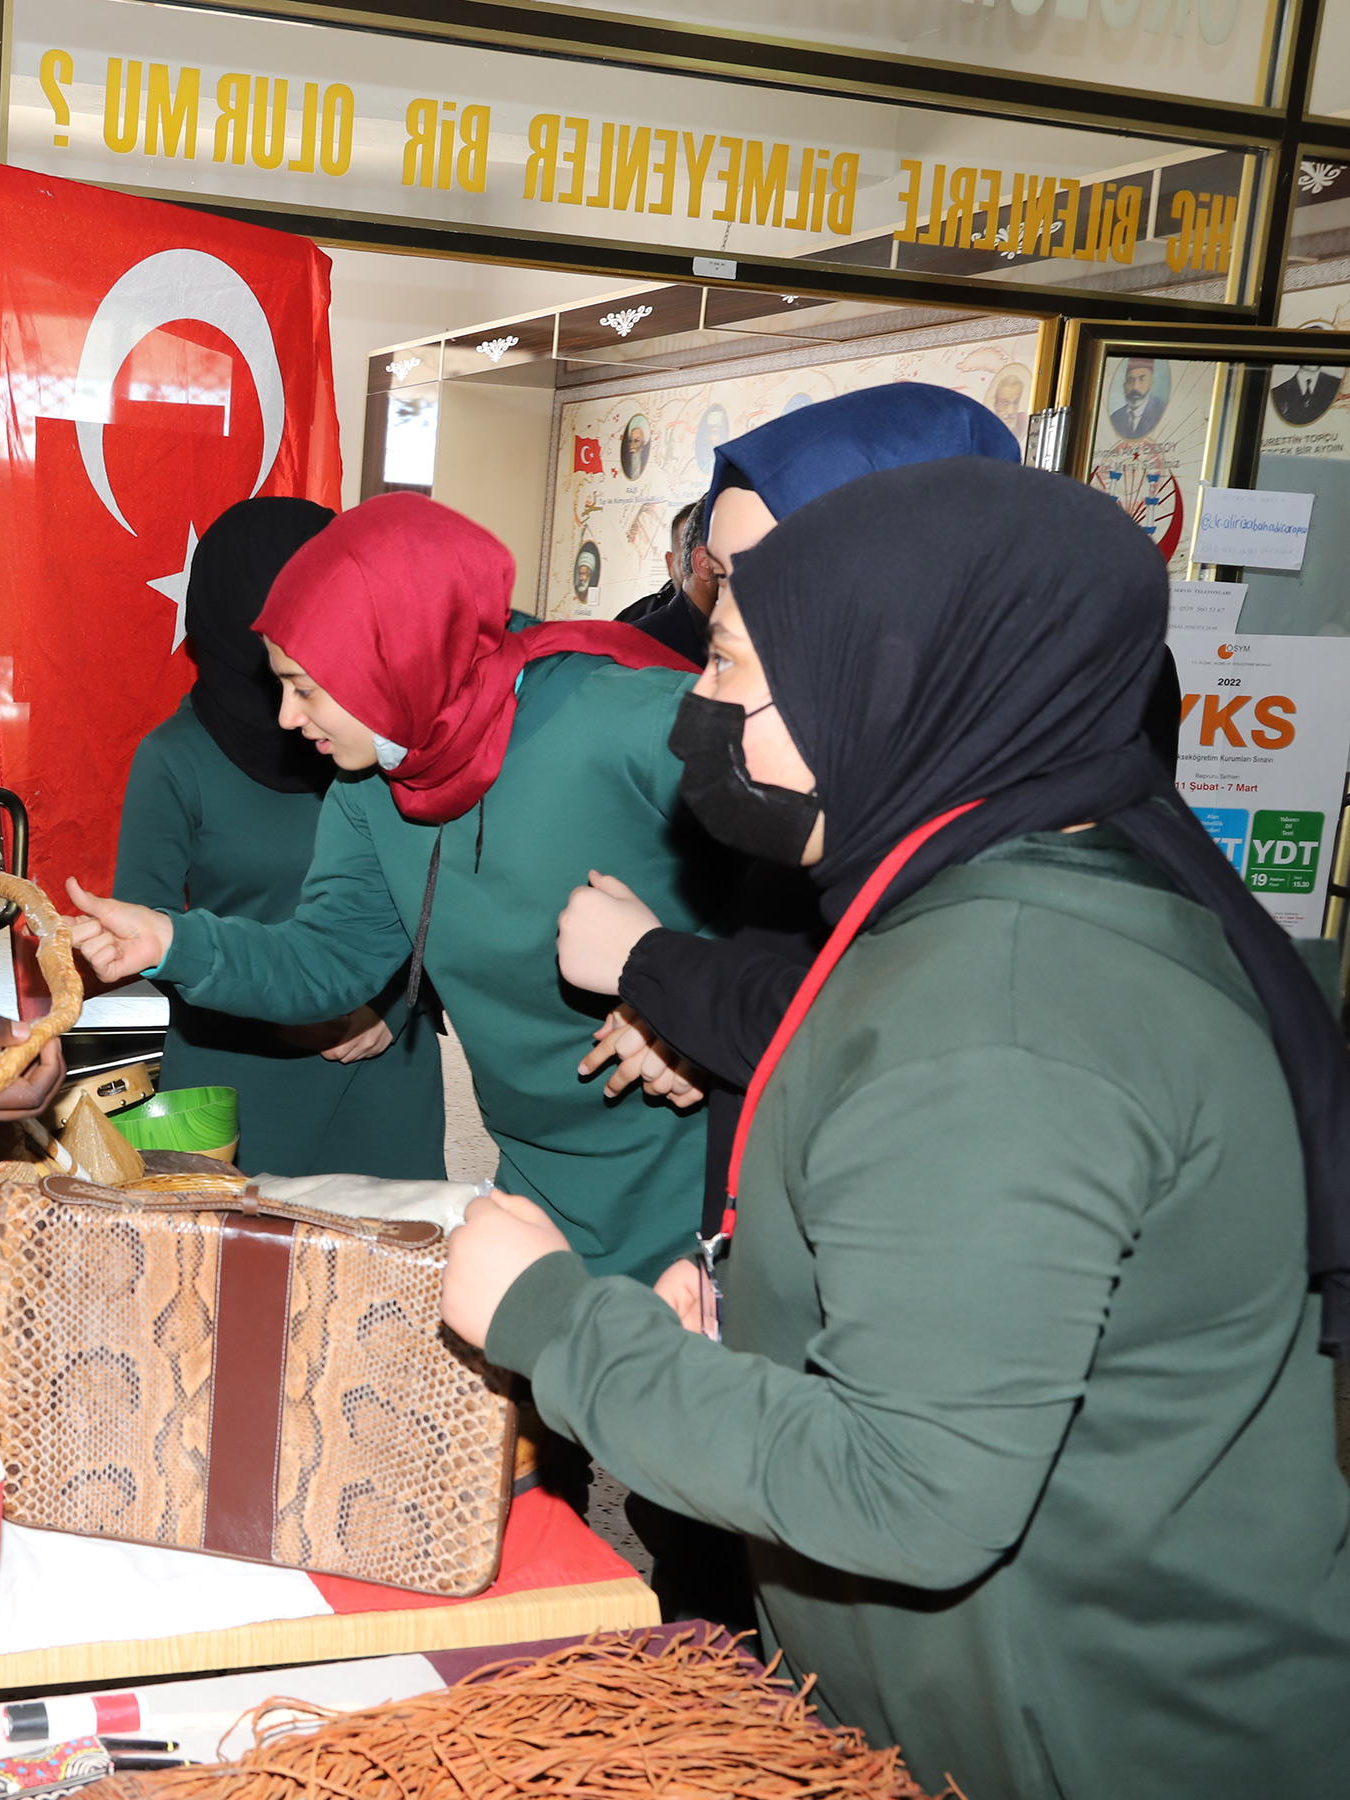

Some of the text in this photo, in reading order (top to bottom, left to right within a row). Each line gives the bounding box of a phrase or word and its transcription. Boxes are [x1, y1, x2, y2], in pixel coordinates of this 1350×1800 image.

[1217, 678, 1243, 687] 2022
[1219, 755, 1253, 764] Kurumları
[1253, 755, 1275, 764] Sınavı
[1190, 781, 1219, 793] Şubat
[1227, 784, 1235, 792] 7
[1236, 784, 1259, 793] Mart
[1253, 840, 1319, 865] YDT
[1250, 873, 1268, 887] 19
